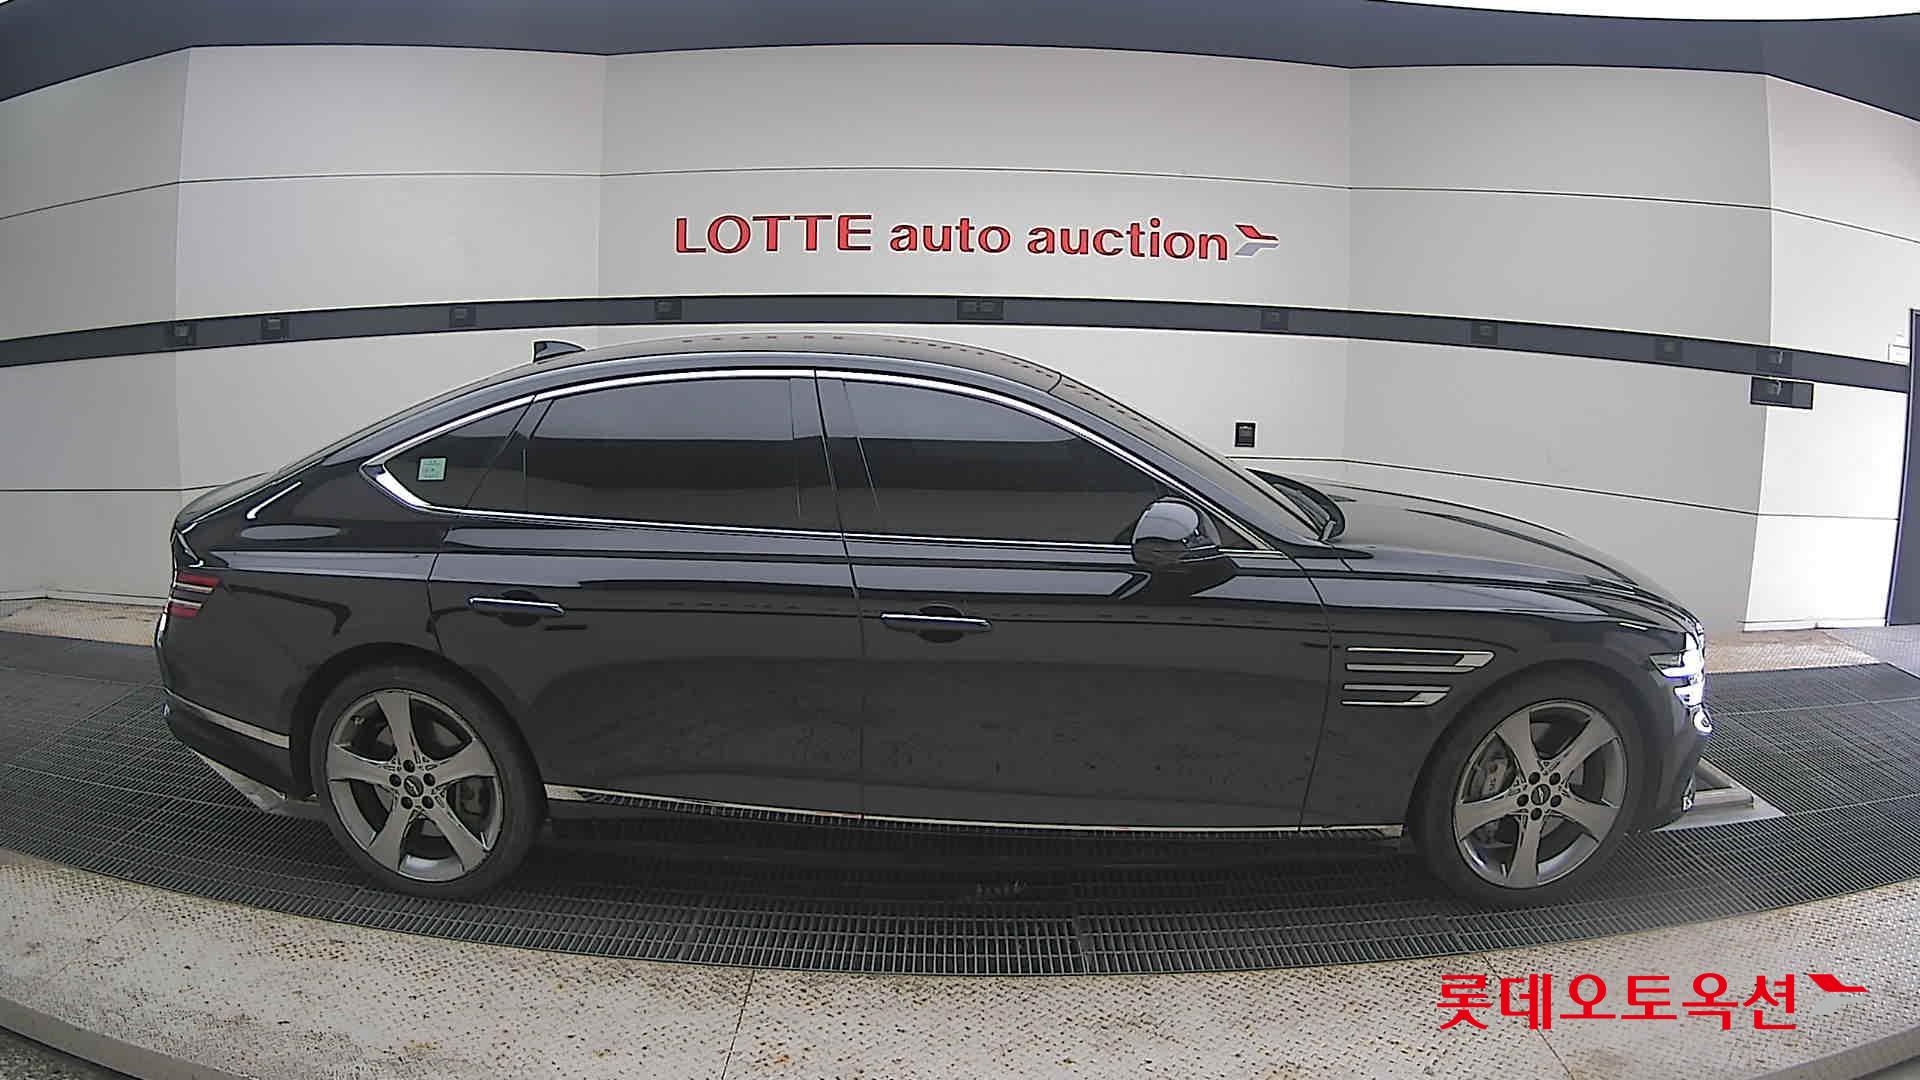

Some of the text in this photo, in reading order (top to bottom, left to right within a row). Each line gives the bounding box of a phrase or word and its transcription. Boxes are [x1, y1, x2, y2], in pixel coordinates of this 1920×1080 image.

[675, 214, 1229, 260] LOTTE auto auction
